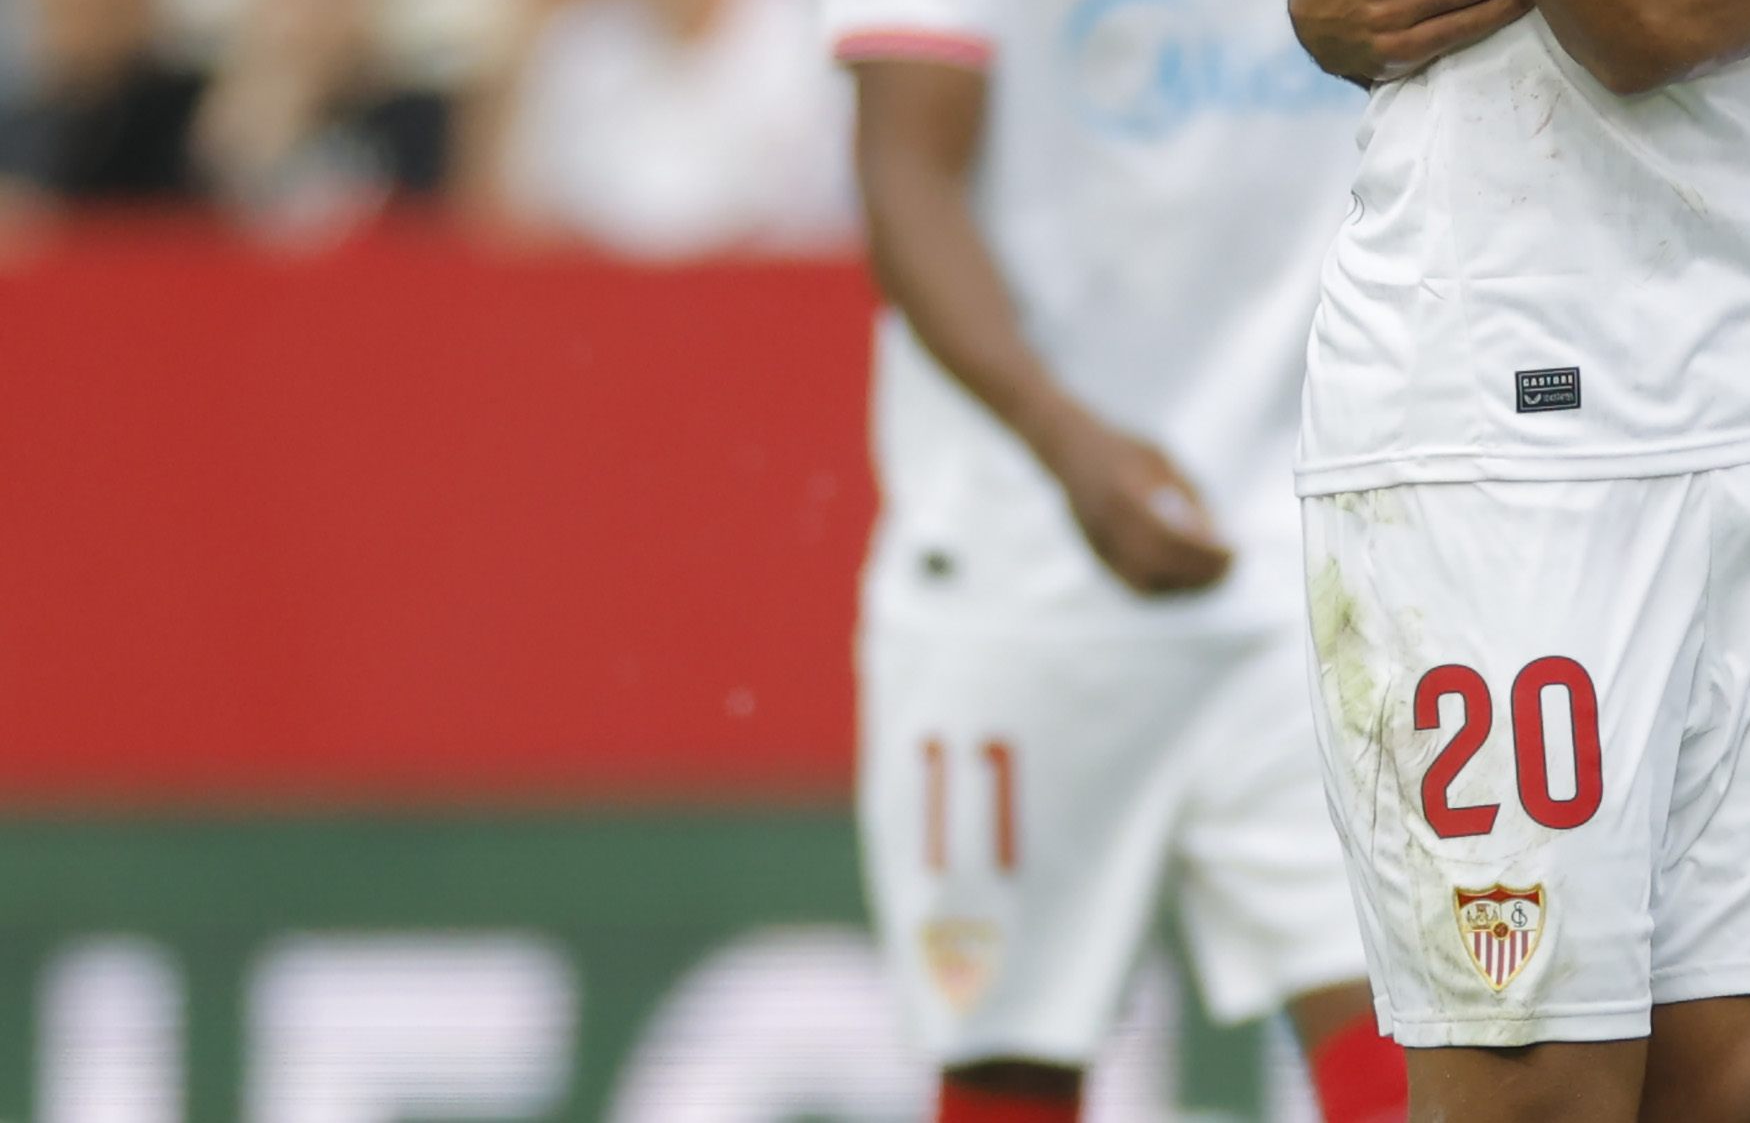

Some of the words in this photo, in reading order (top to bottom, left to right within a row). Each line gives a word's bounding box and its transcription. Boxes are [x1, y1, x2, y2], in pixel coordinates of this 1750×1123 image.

[1522, 374, 1574, 387] CASTORE
[918, 739, 1014, 872] 11
[1413, 655, 1604, 840] 20
